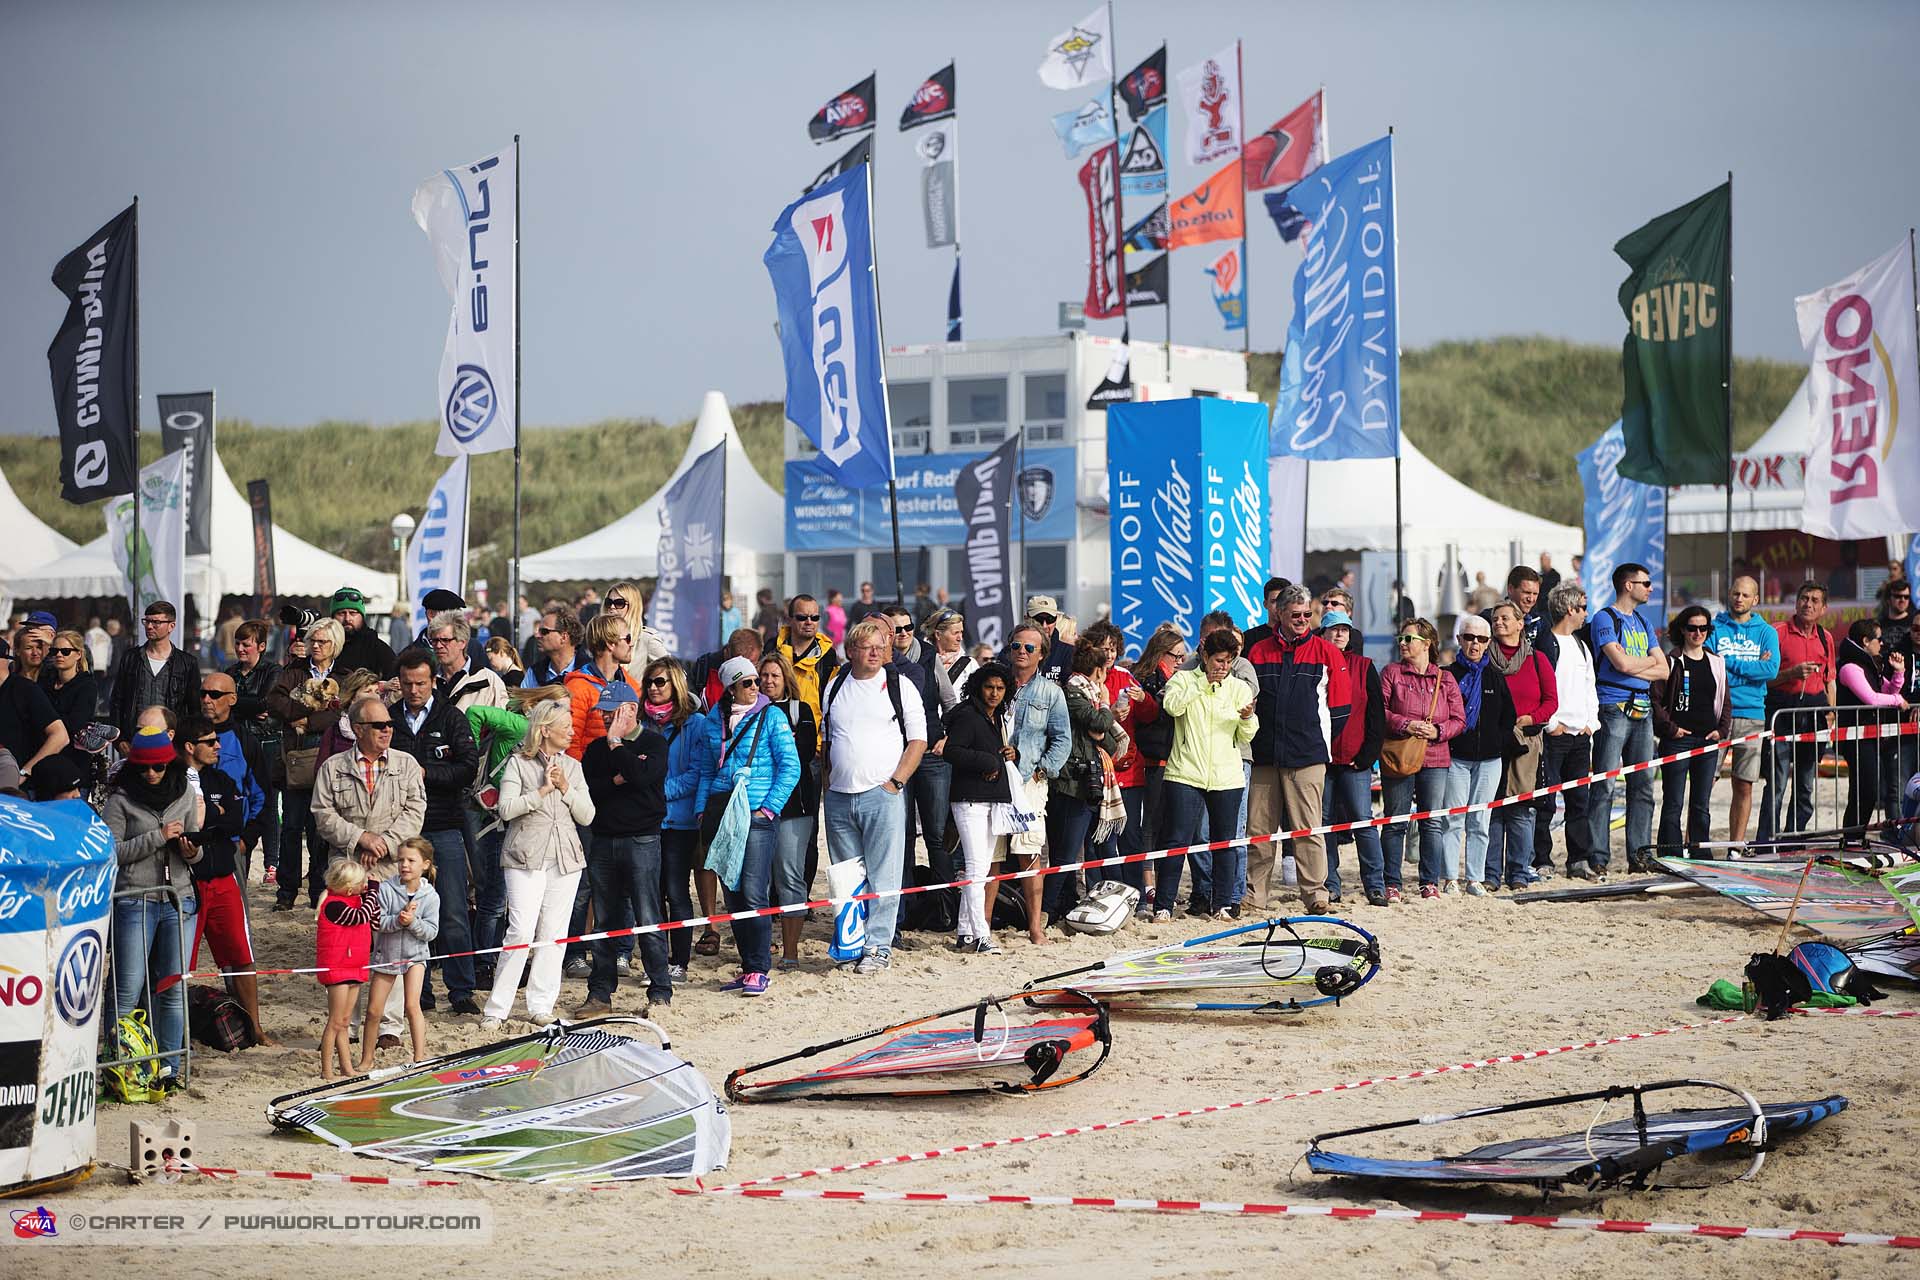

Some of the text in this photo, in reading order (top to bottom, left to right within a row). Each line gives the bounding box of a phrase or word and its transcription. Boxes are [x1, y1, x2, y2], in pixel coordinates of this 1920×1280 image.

[1151, 459, 1193, 583] Water
[1207, 465, 1227, 611] VIDOFF
[1230, 461, 1261, 585] Water
[1119, 470, 1142, 662] DAVIDOFF
[0, 876, 31, 919] ter
[57, 867, 105, 912] Cool
[0, 976, 42, 1007] NO
[0, 1084, 36, 1105] DAVID
